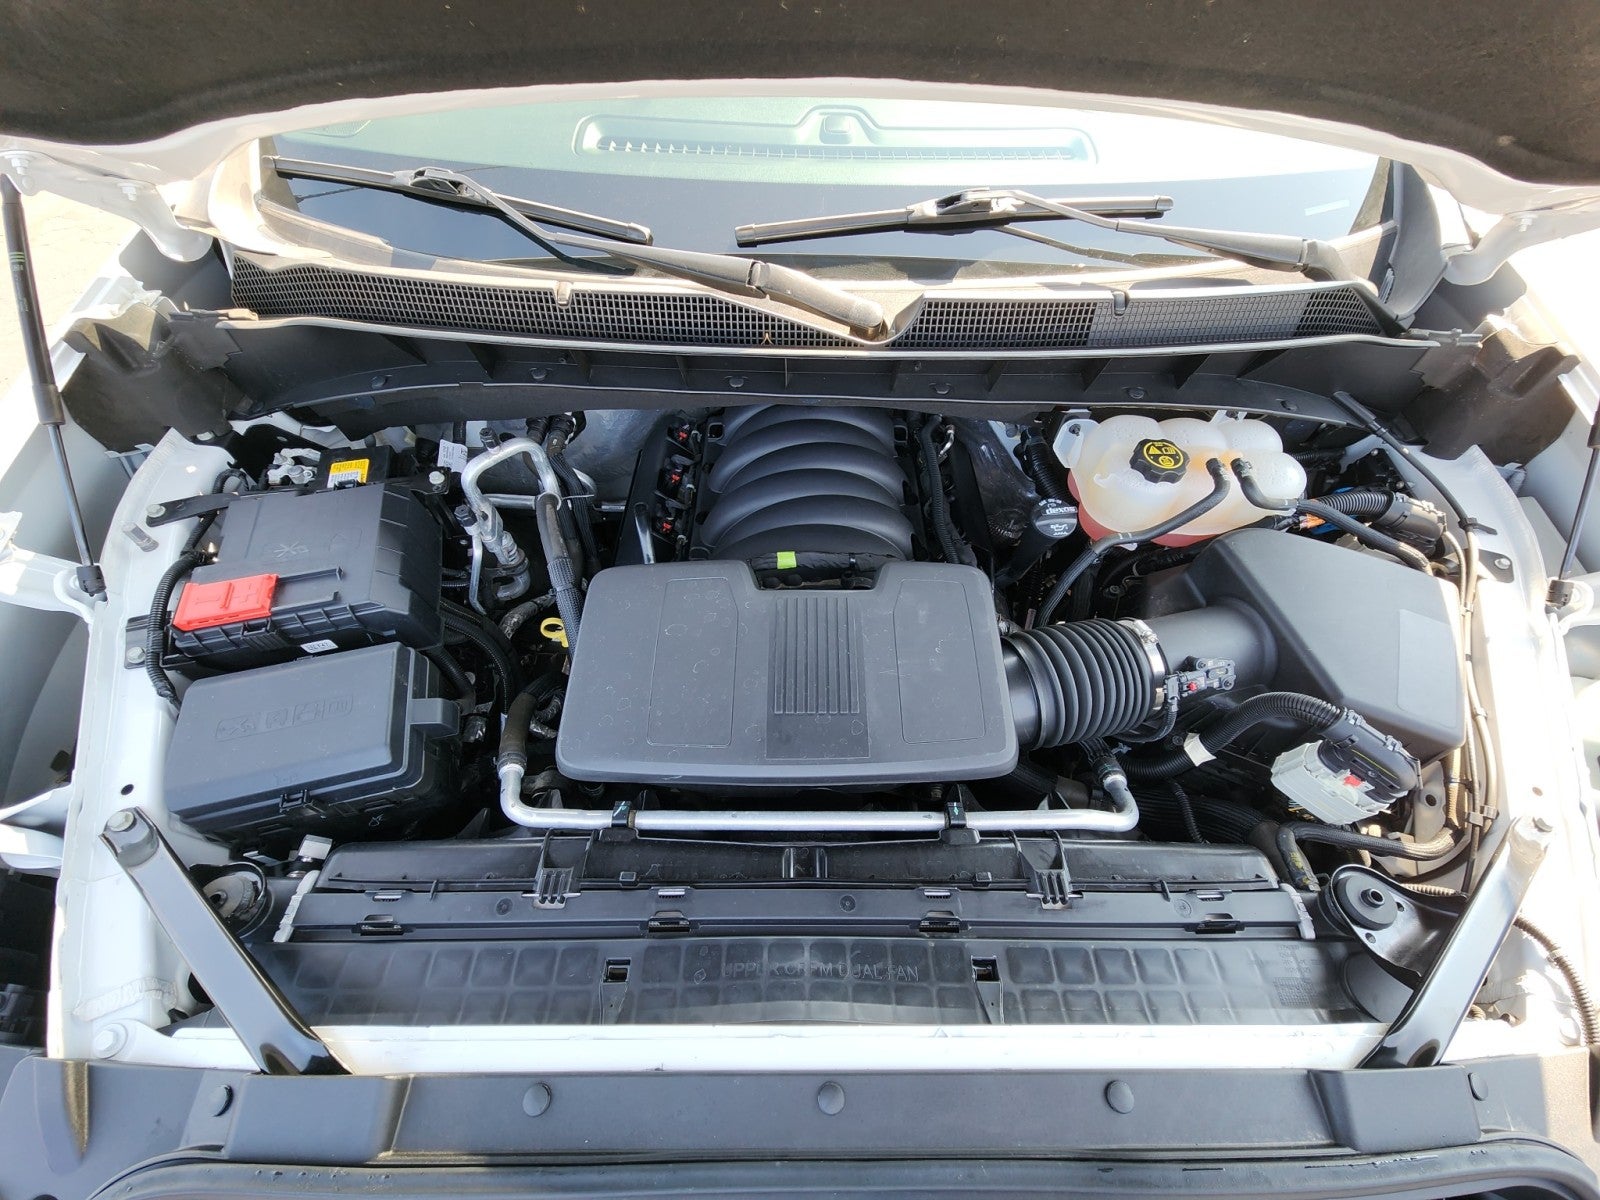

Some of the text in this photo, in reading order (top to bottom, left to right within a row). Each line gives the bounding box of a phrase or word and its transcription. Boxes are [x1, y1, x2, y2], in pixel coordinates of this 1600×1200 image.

[1046, 506, 1076, 515] dexos
[839, 962, 883, 980] DUAL
[887, 965, 920, 983] FAN
